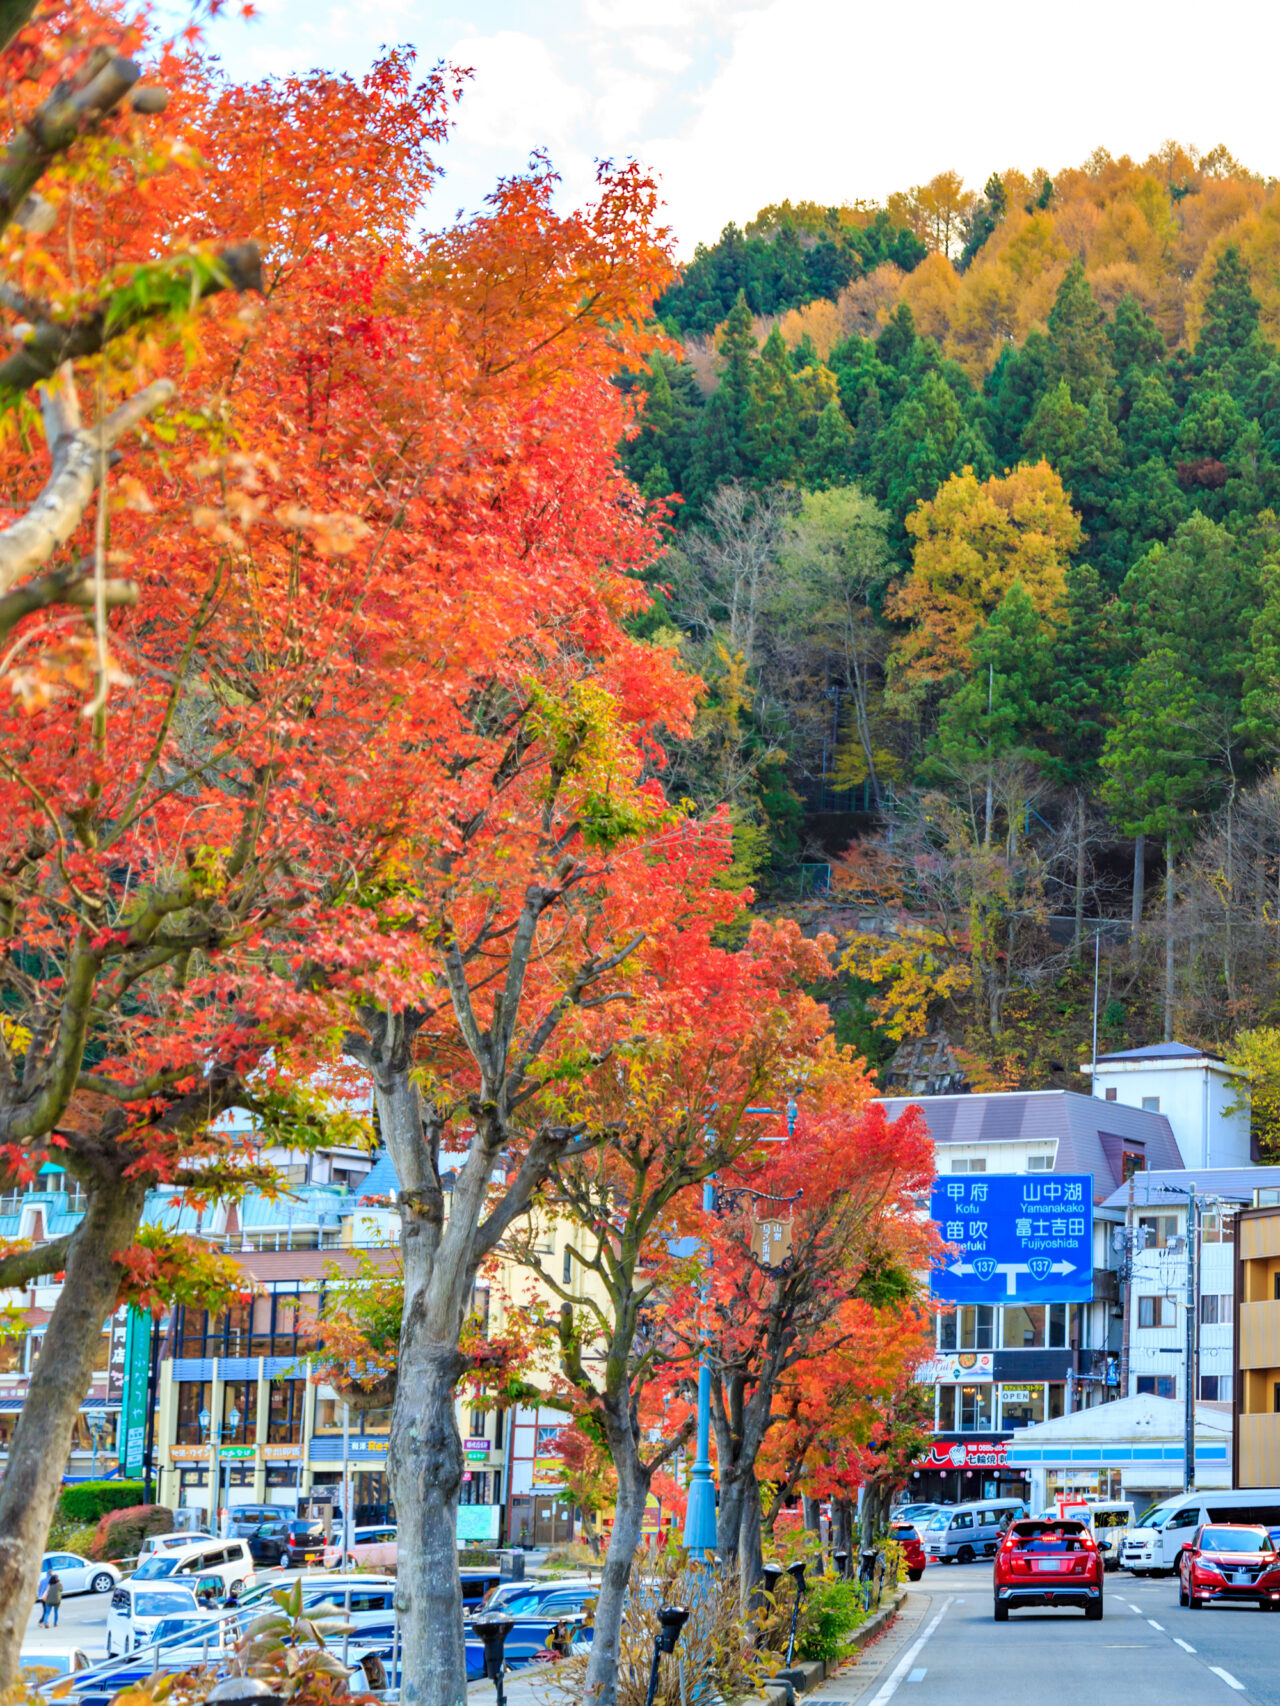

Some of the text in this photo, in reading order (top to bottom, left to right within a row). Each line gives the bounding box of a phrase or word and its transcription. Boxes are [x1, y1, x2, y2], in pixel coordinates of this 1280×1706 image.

[947, 1183, 988, 1202] 甲府
[1023, 1182, 1082, 1202] 山中湖
[955, 1203, 980, 1214] Kofu
[1020, 1203, 1085, 1214] Yamanakako
[946, 1220, 988, 1239] 笛吹
[1016, 1218, 1085, 1237] 富士吉田
[955, 1241, 986, 1251] efuki
[1021, 1238, 1079, 1250] Fujiyoshida
[977, 1261, 994, 1272] 137
[1031, 1261, 1049, 1271] 137
[368, 1440, 389, 1451] Res
